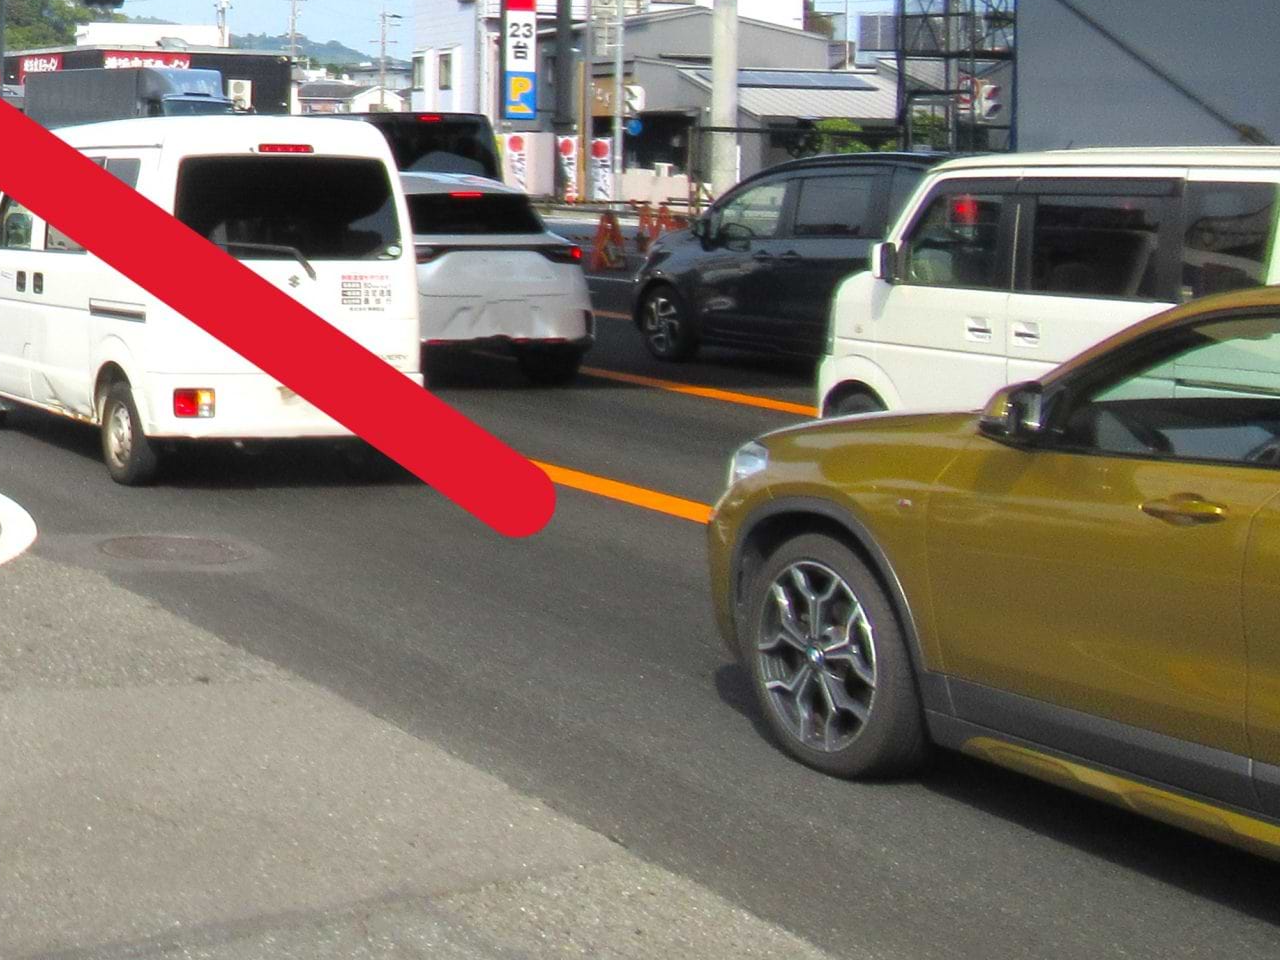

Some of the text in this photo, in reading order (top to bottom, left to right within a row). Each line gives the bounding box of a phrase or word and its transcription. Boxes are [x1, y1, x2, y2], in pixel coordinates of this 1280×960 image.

[509, 22, 533, 38] 23
[512, 41, 528, 60] 台
[510, 76, 533, 102] P
